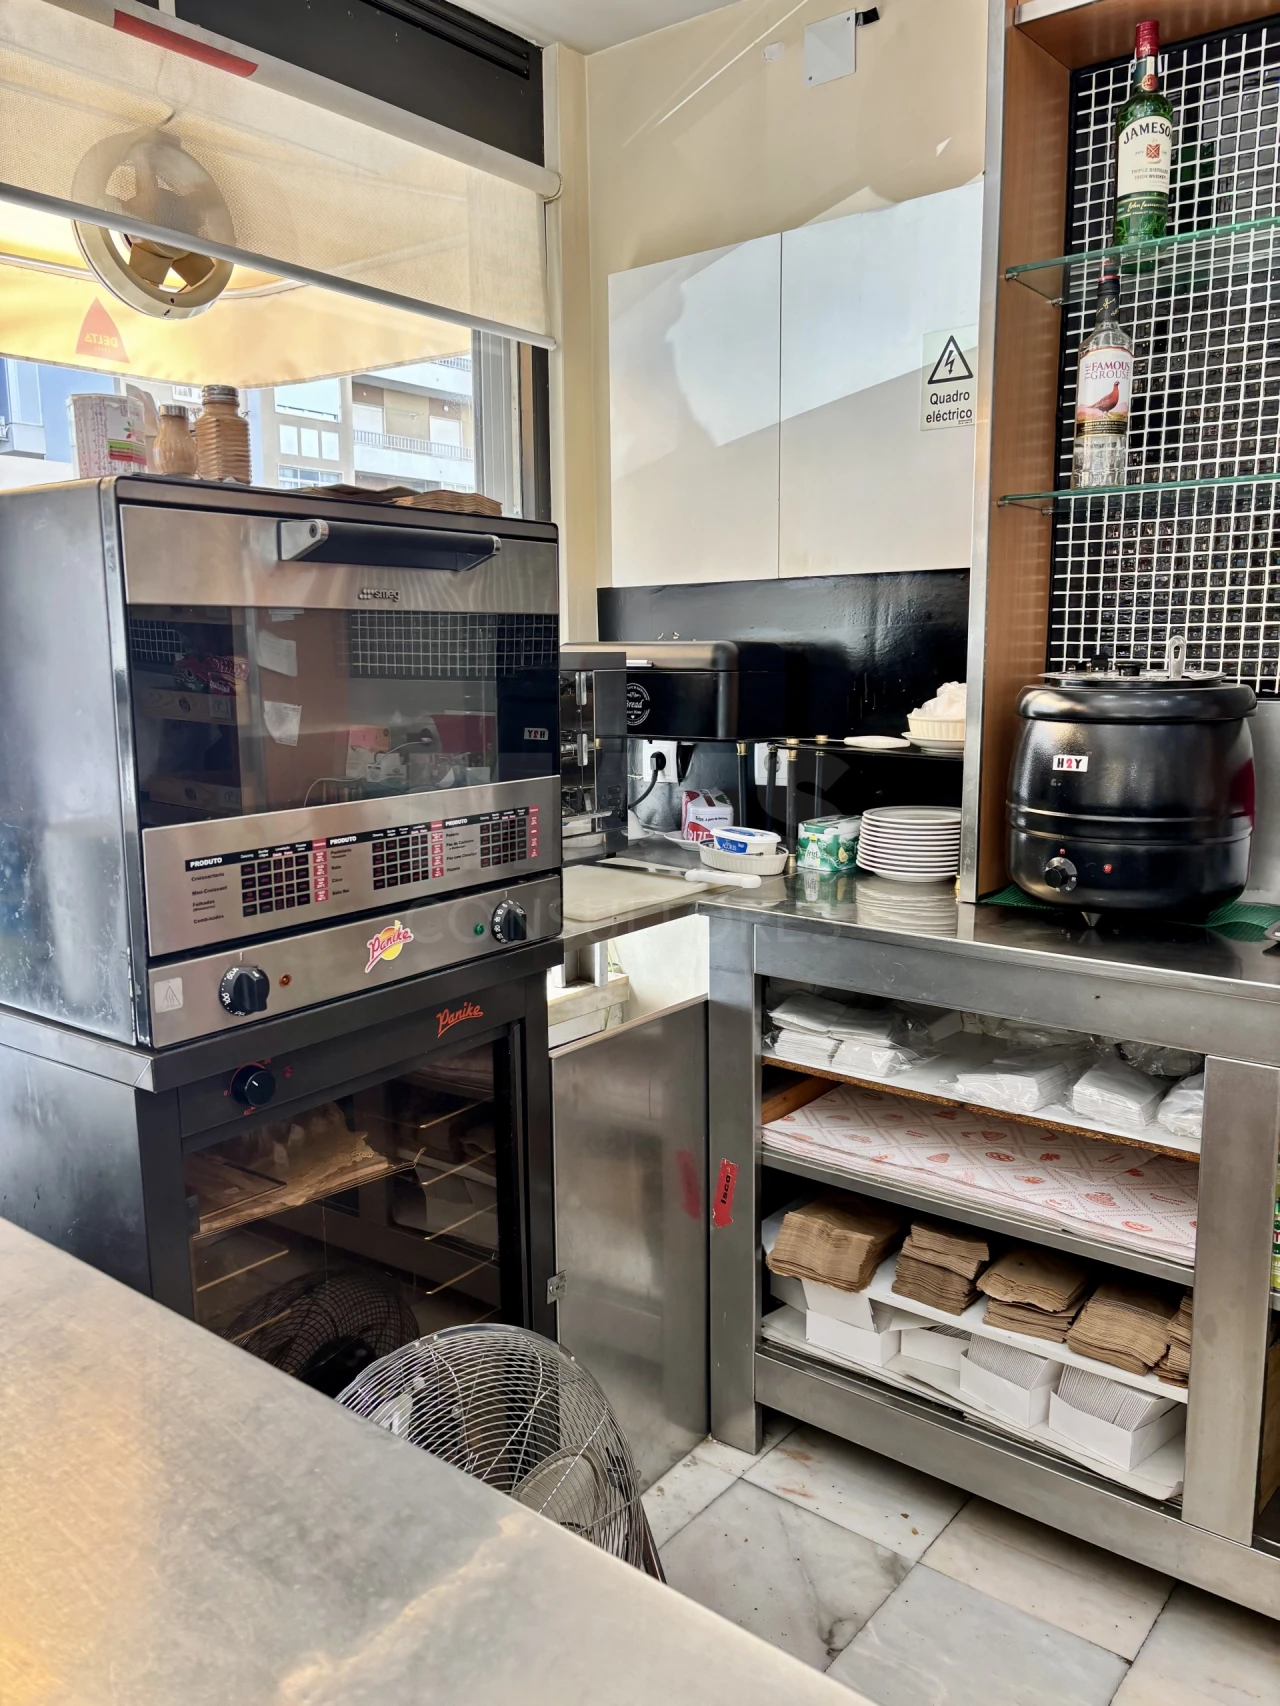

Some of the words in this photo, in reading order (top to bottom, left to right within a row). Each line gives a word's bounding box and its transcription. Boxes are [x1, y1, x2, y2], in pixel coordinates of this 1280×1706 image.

[1092, 361, 1131, 372] FAMOUS
[1091, 370, 1130, 380] GROUSE
[929, 390, 970, 405] Quadro
[926, 408, 973, 423] eléctrico
[374, 589, 400, 602] smeg
[1056, 758, 1082, 769] H2Y
[330, 835, 357, 846] PRODUTO
[189, 857, 222, 868] PRODUTO
[365, 924, 414, 973] Panike
[436, 1002, 484, 1039] Panike
